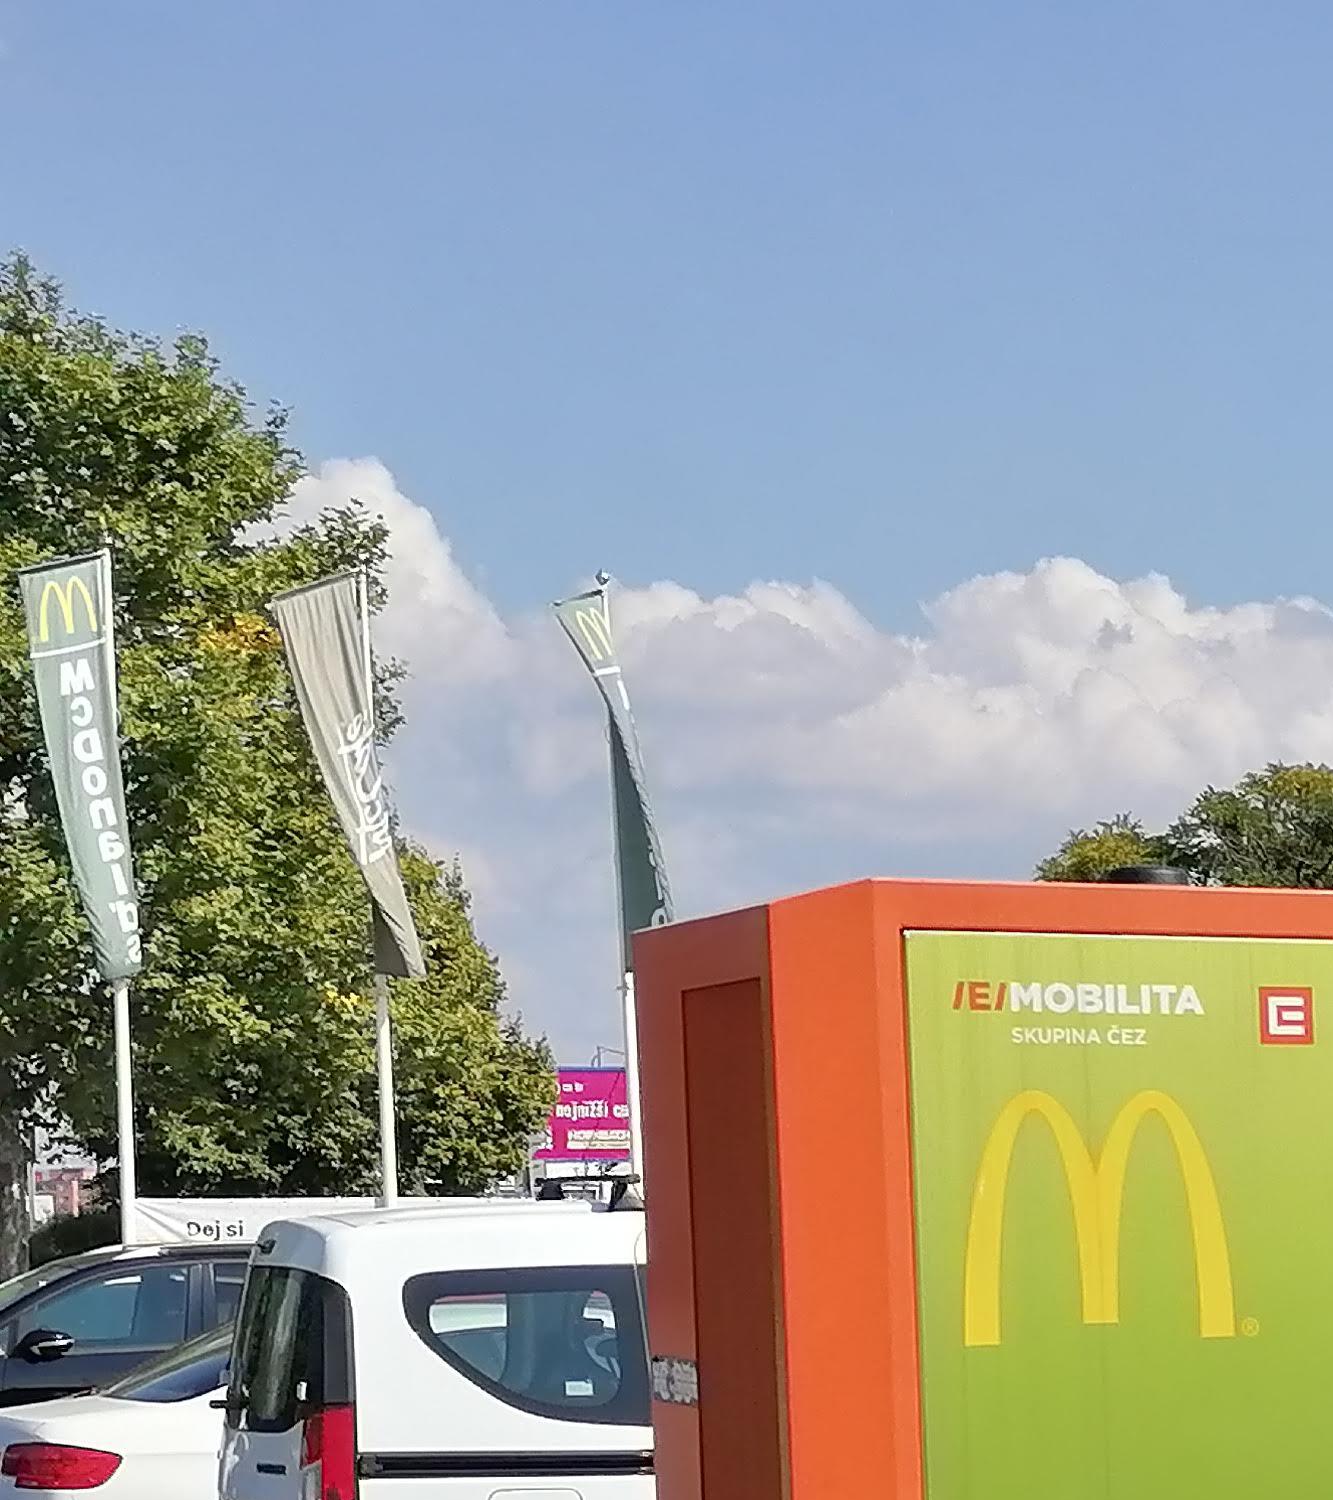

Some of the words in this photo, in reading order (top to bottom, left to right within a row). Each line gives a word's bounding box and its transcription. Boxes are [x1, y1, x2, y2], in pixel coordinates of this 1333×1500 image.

[1011, 1026, 1102, 1045] SKUPINA
[1107, 1024, 1148, 1045] ČEZ
[226, 1220, 243, 1237] si
